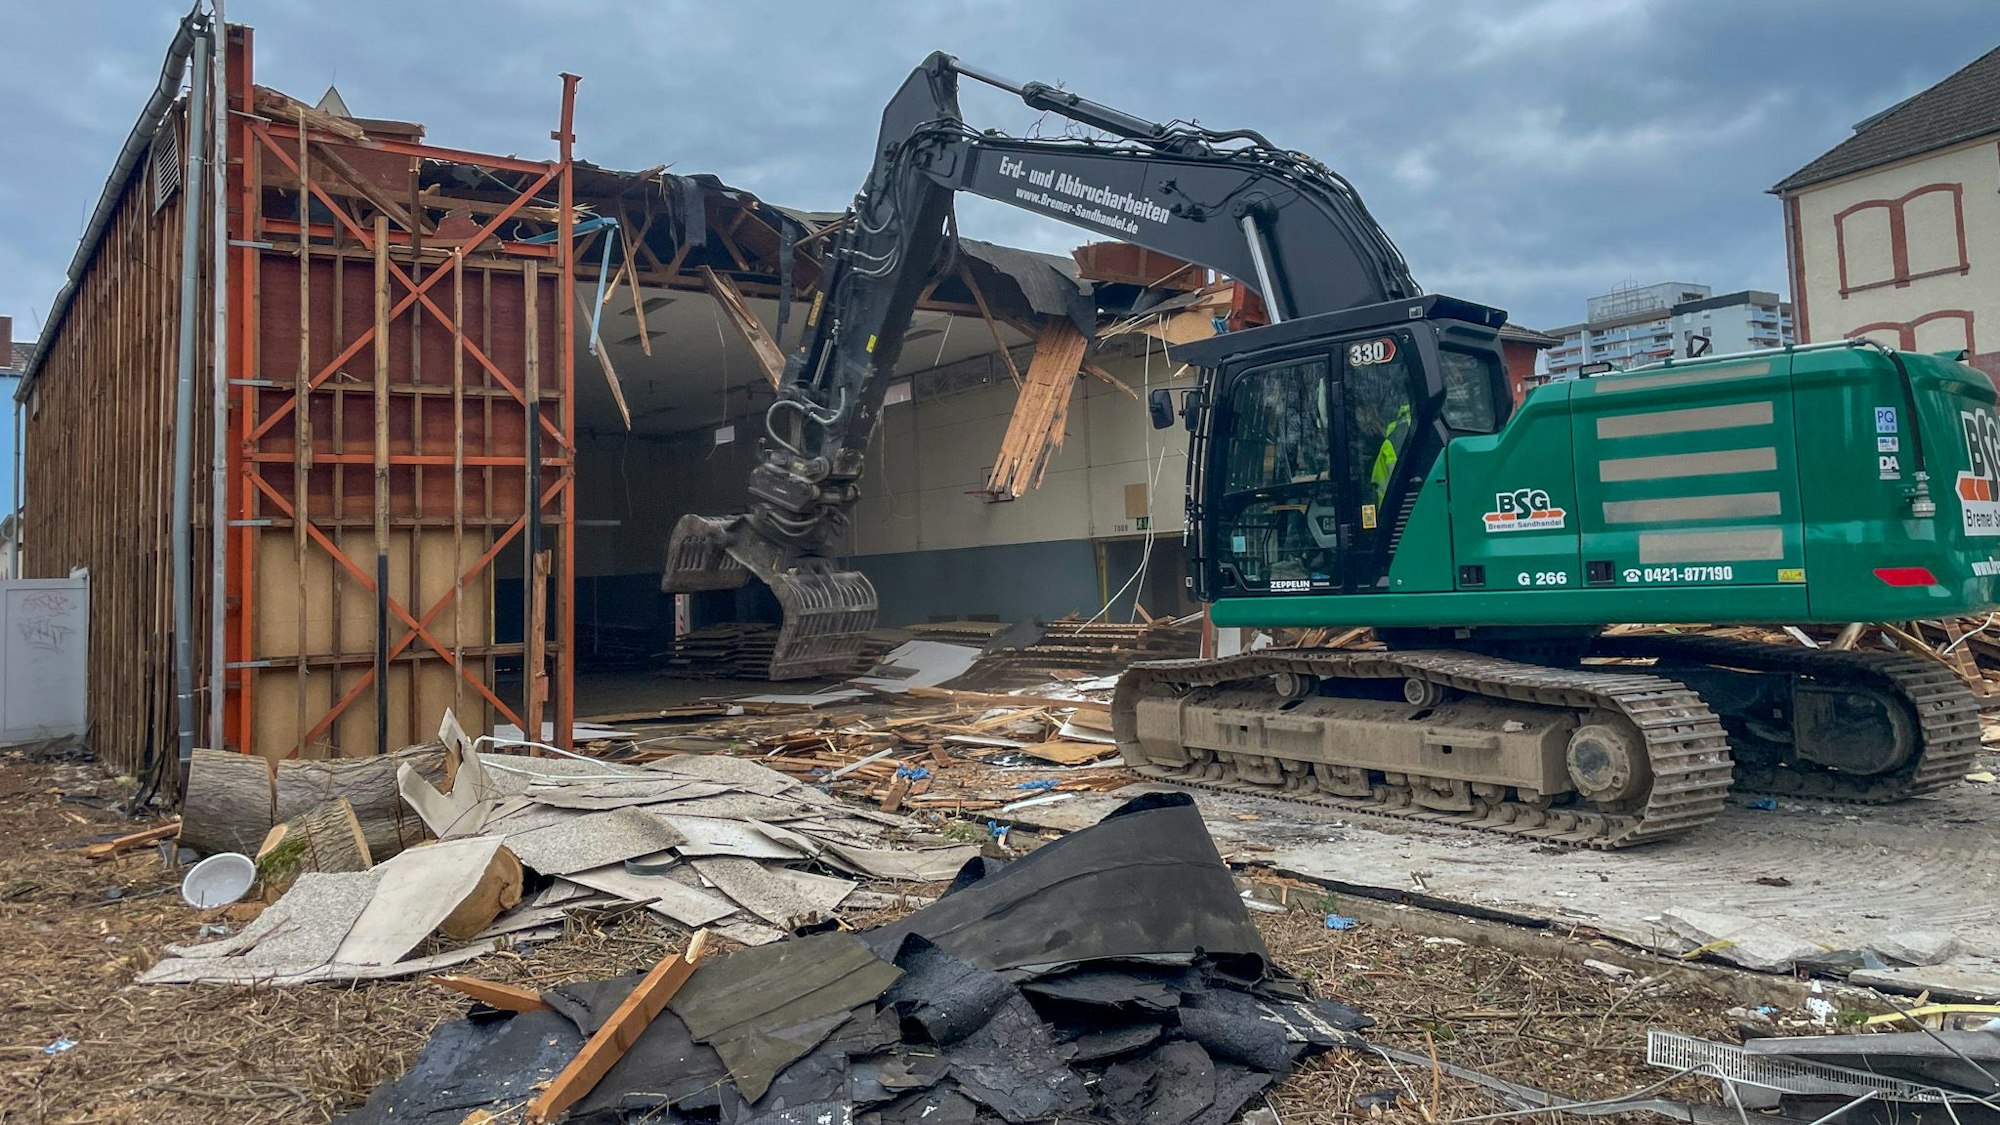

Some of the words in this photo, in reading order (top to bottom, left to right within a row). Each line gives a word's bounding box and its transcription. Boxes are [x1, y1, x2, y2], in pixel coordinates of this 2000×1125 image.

[999, 155, 1026, 179] Erd-
[1029, 167, 1054, 189] und
[1054, 172, 1170, 225] Abbrucharbeiten
[1015, 186, 1139, 235] www.Bremer-Sandhandel.de
[1351, 341, 1385, 364] 330
[1877, 410, 1895, 423] PQ
[1498, 489, 1549, 520] BSG
[1517, 519, 1562, 528] Sandhandel
[1966, 509, 1993, 528] Bremer
[1518, 572, 1531, 585] G
[1536, 571, 1568, 585] 266
[1644, 566, 1733, 582] 0421-877190
[1270, 580, 1310, 588] ZEPPELIN
